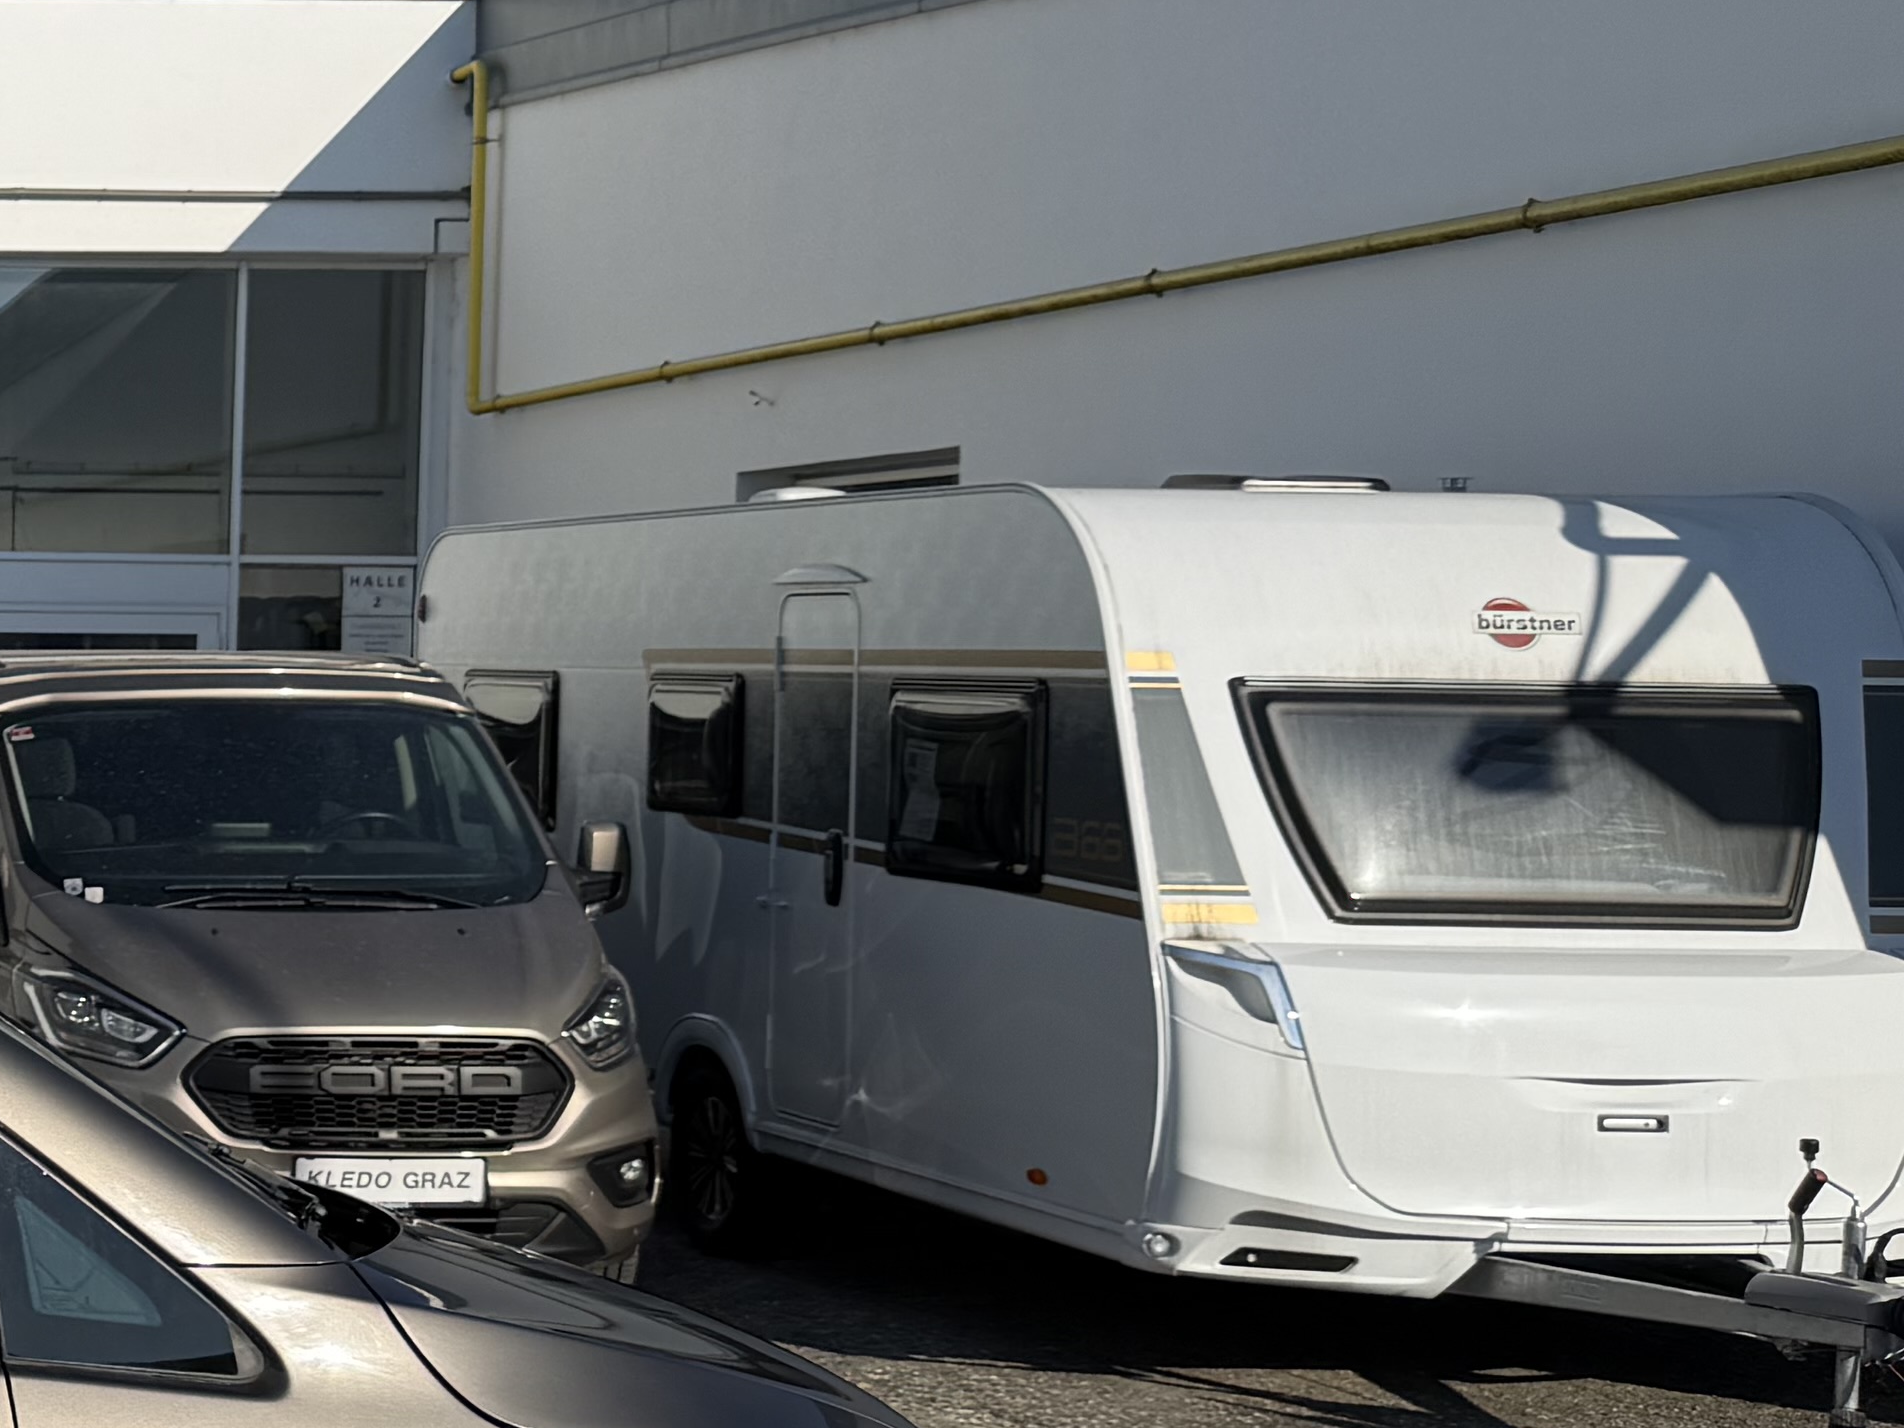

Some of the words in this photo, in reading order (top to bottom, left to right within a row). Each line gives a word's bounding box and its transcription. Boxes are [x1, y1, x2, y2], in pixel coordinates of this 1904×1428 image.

[350, 575, 406, 588] HALLE
[373, 595, 382, 608] 2
[1477, 613, 1576, 631] bürstner
[249, 1064, 523, 1096] FORD
[307, 1171, 393, 1189] KLEDO
[402, 1172, 471, 1189] GRAZ
